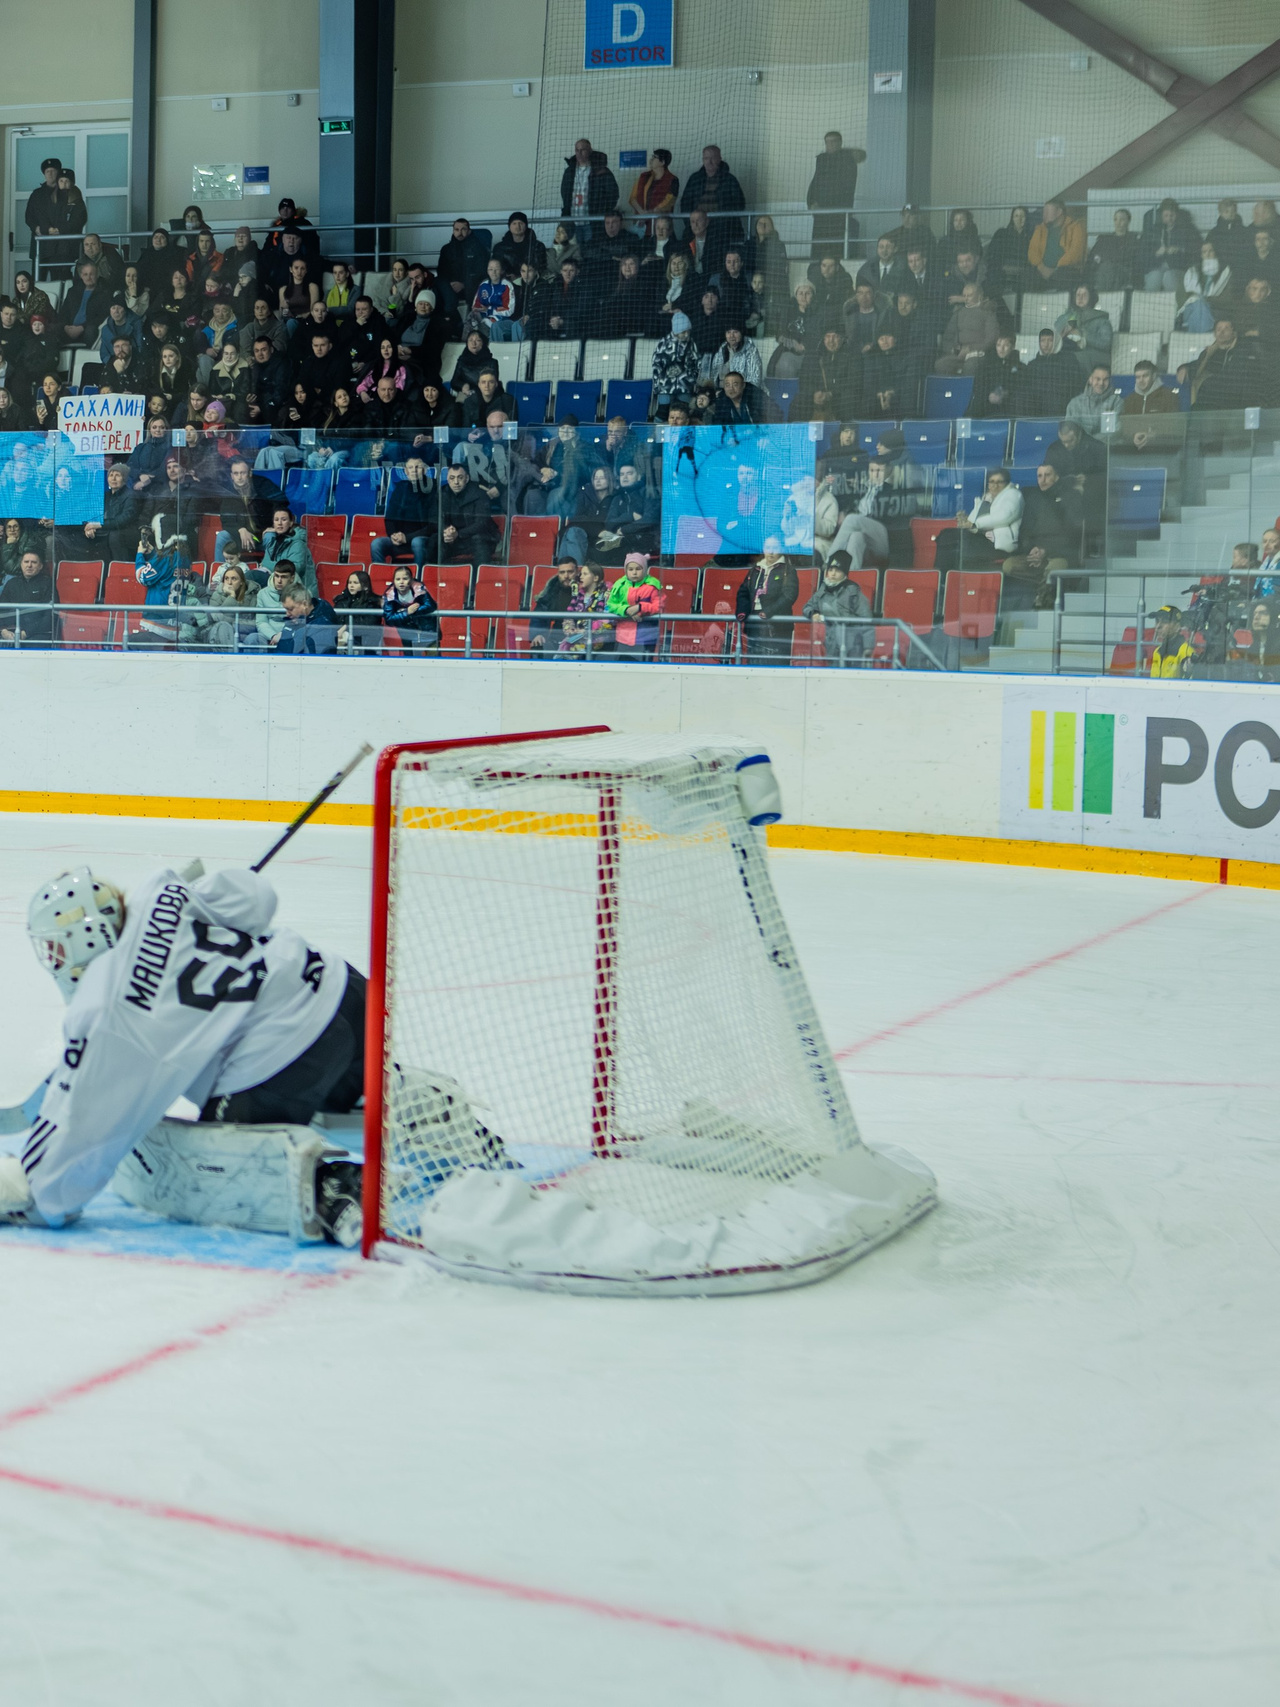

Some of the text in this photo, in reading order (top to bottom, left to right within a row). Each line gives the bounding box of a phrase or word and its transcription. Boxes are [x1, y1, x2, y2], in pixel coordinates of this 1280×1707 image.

[612, 3, 645, 44] D
[591, 46, 665, 64] SECTOR
[63, 398, 144, 419] САХАЛИН
[65, 420, 113, 433] ТОЛЬКО
[124, 884, 189, 1012] МАШКОВА
